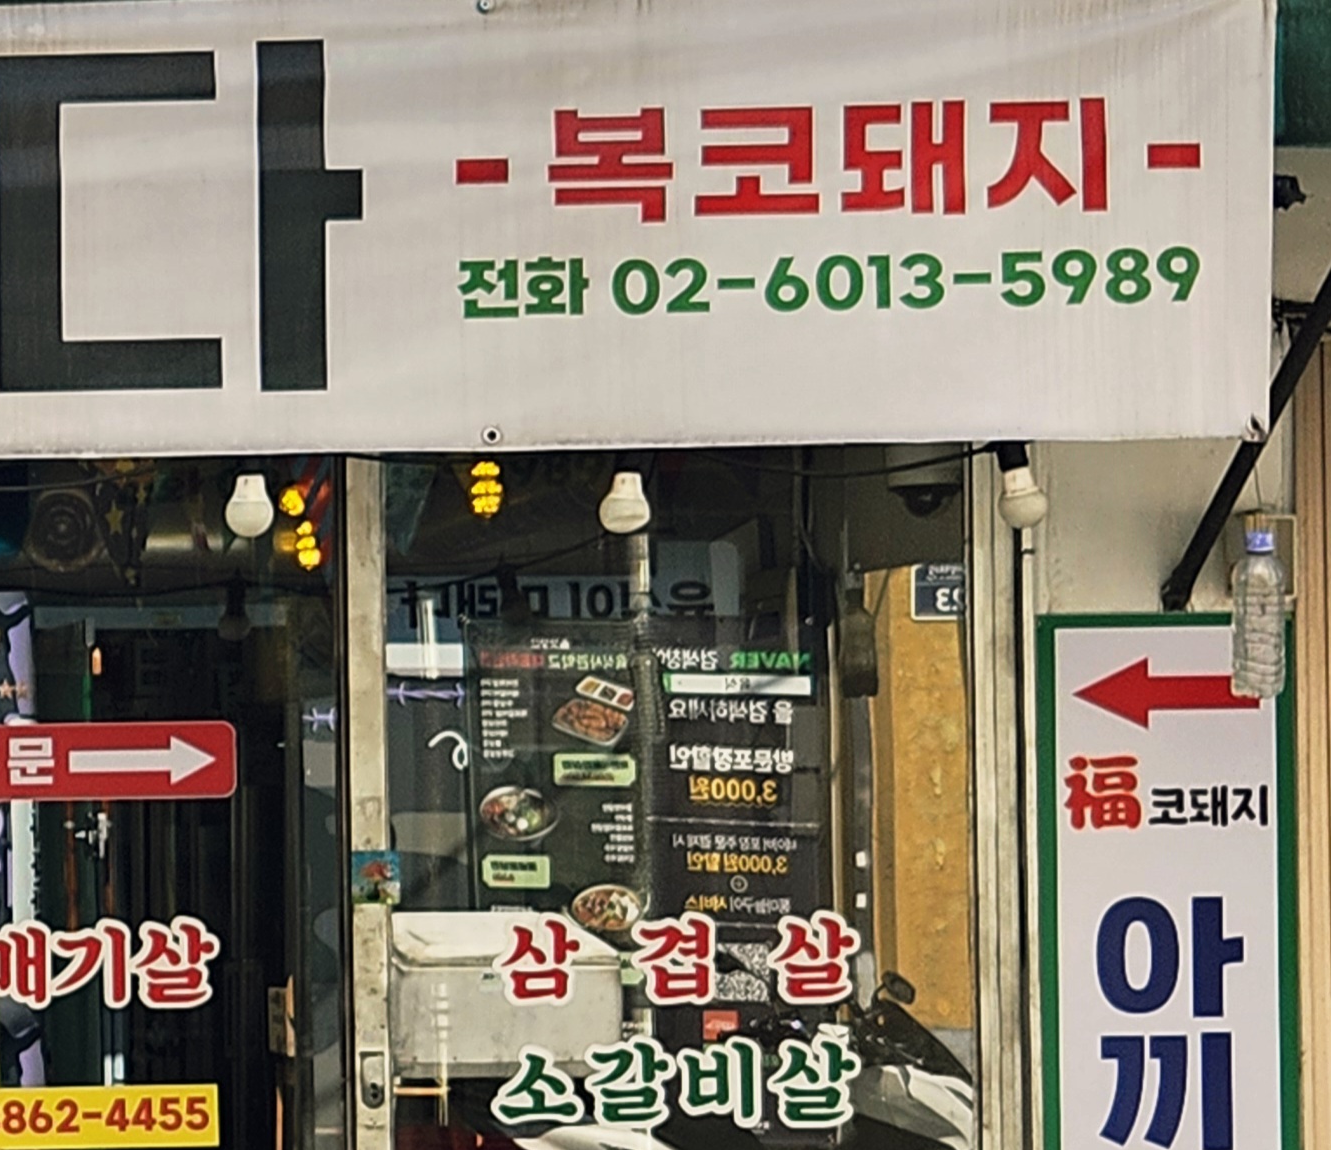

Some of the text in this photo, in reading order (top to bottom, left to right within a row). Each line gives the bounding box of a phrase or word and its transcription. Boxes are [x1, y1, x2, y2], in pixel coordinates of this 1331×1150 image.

[547, 97, 1110, 224] 복코돼지
[457, 245, 1203, 320] 전화 02-6013-5989
[492, 1036, 861, 1127] 소갈비살
